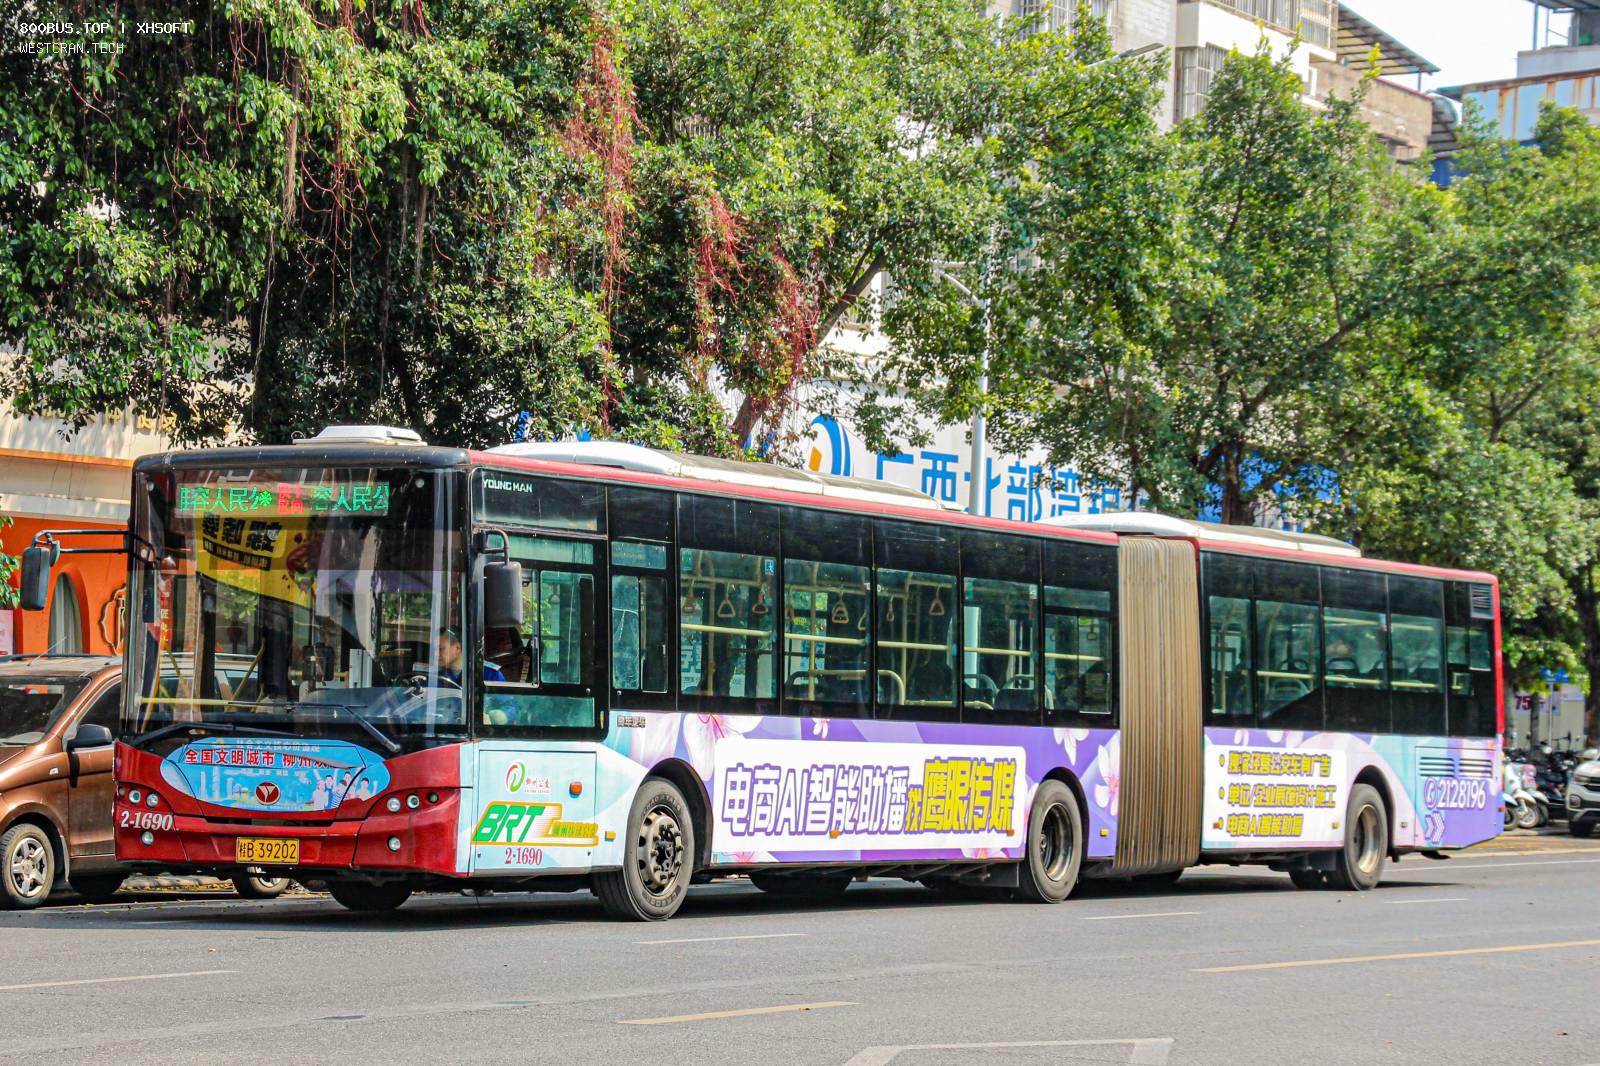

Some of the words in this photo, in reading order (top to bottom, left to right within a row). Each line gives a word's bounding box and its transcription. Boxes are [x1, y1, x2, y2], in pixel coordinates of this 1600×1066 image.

[482, 478, 512, 491] YOUNG
[513, 481, 533, 493] MAN
[877, 451, 1148, 522] 广西北部湾
[184, 748, 275, 769] 全国文明城市
[1437, 779, 1487, 809] 2128196
[120, 811, 174, 831] 2-1690
[473, 805, 546, 843] BRT
